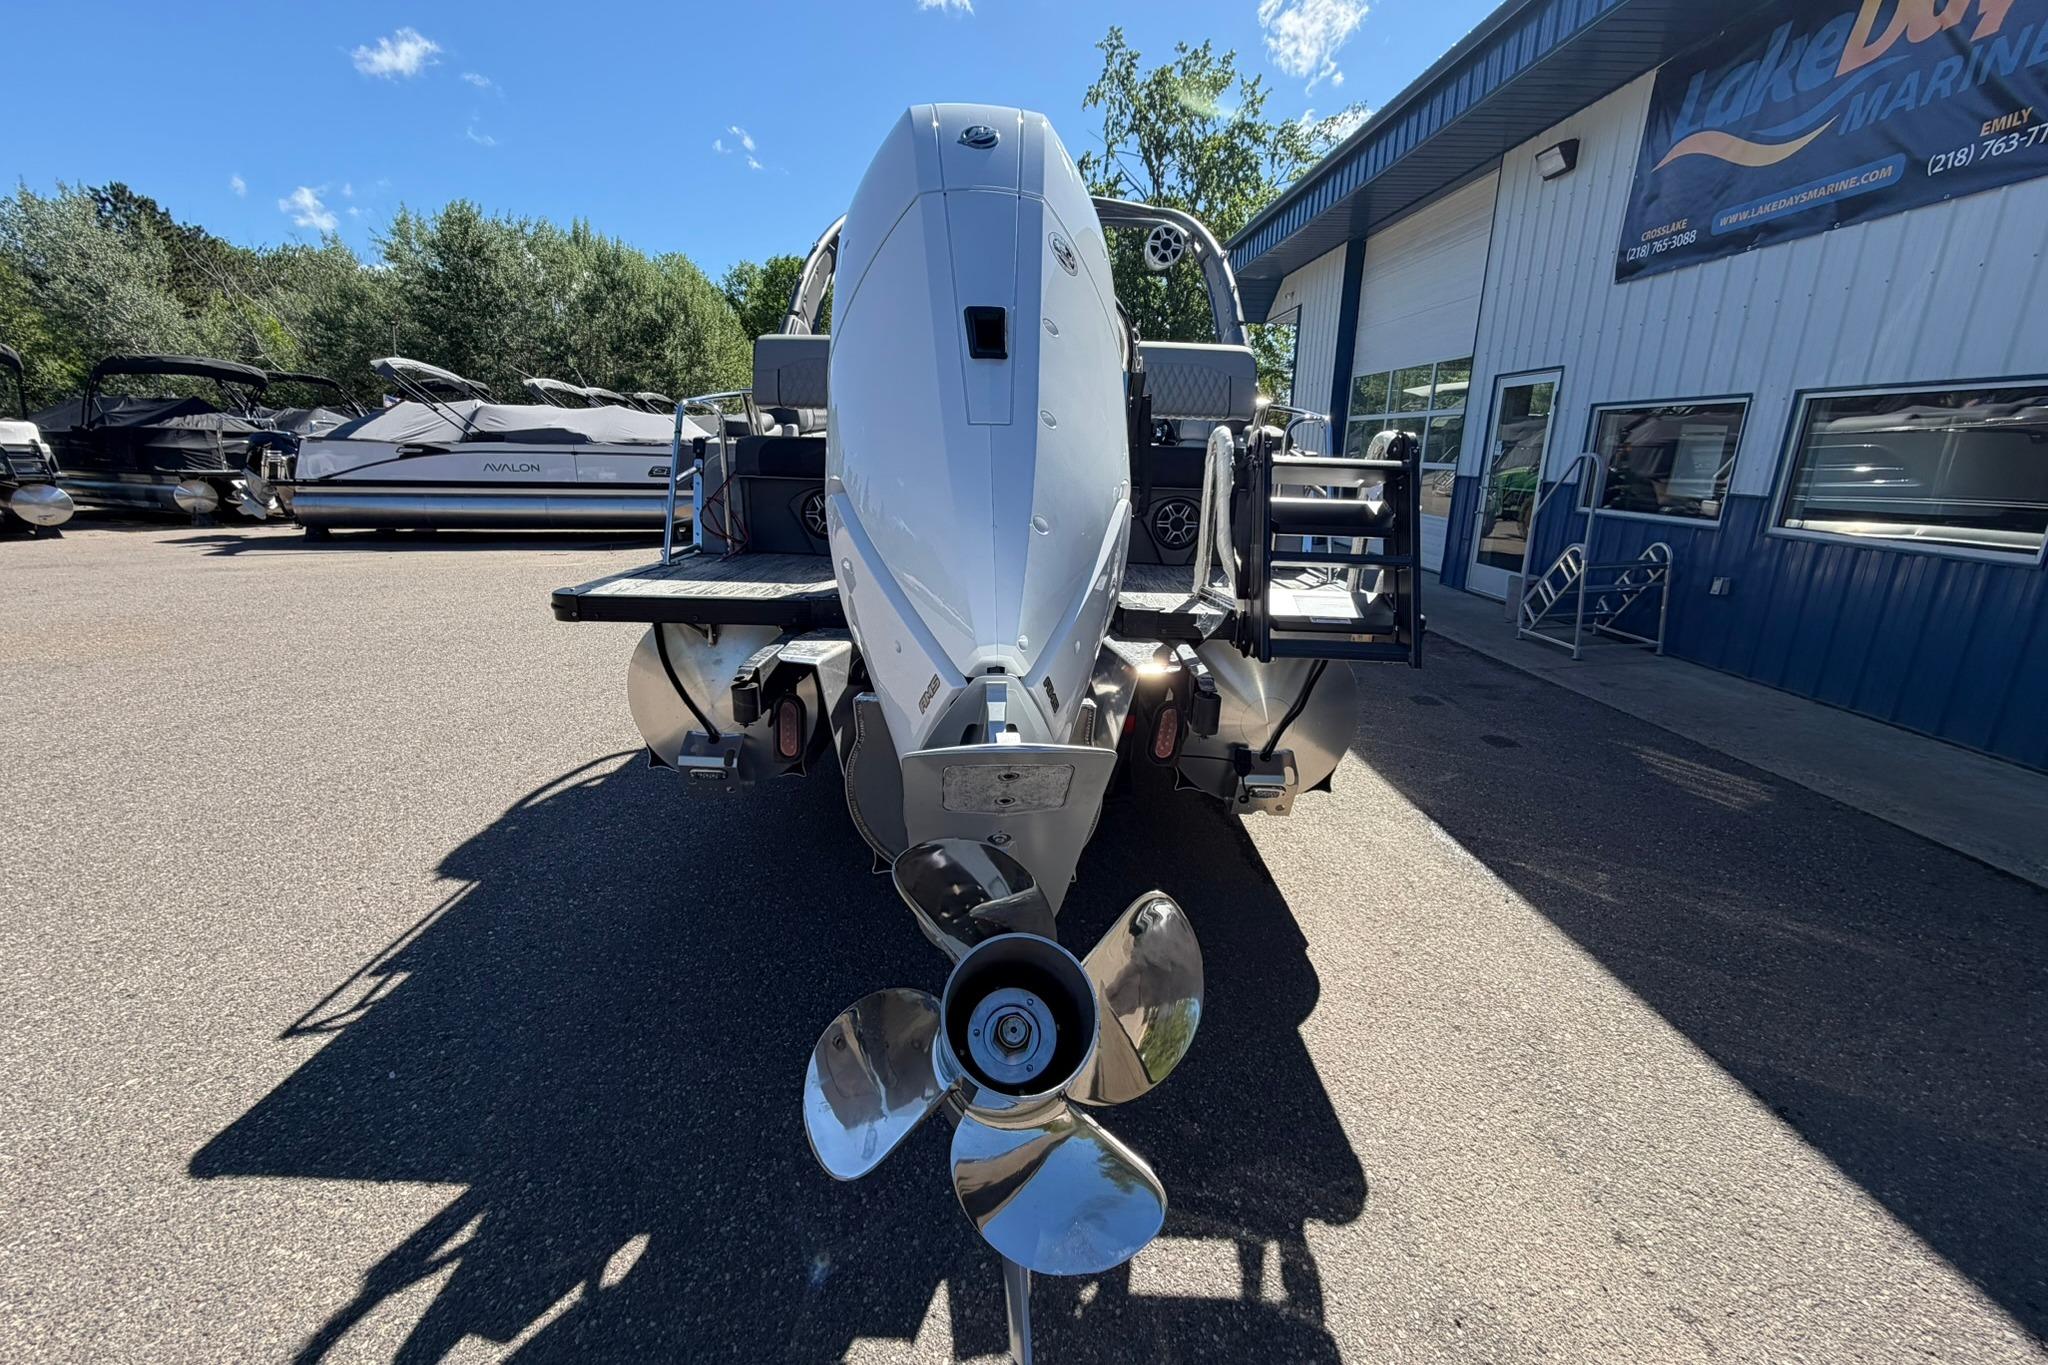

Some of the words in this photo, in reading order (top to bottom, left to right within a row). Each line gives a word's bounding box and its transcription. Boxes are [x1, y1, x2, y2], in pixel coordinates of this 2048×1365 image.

[1979, 106, 2034, 137] EMILY
[1927, 143, 1975, 177] (218)
[1719, 165, 1894, 227] WWW.LAKEDAYSMARINE.COM
[1626, 245, 1650, 263] (218)
[1651, 229, 1697, 255] 765-3088
[1641, 218, 1688, 242] CROSSLAKE
[483, 463, 540, 473] AVALON
[918, 673, 941, 715] AMS
